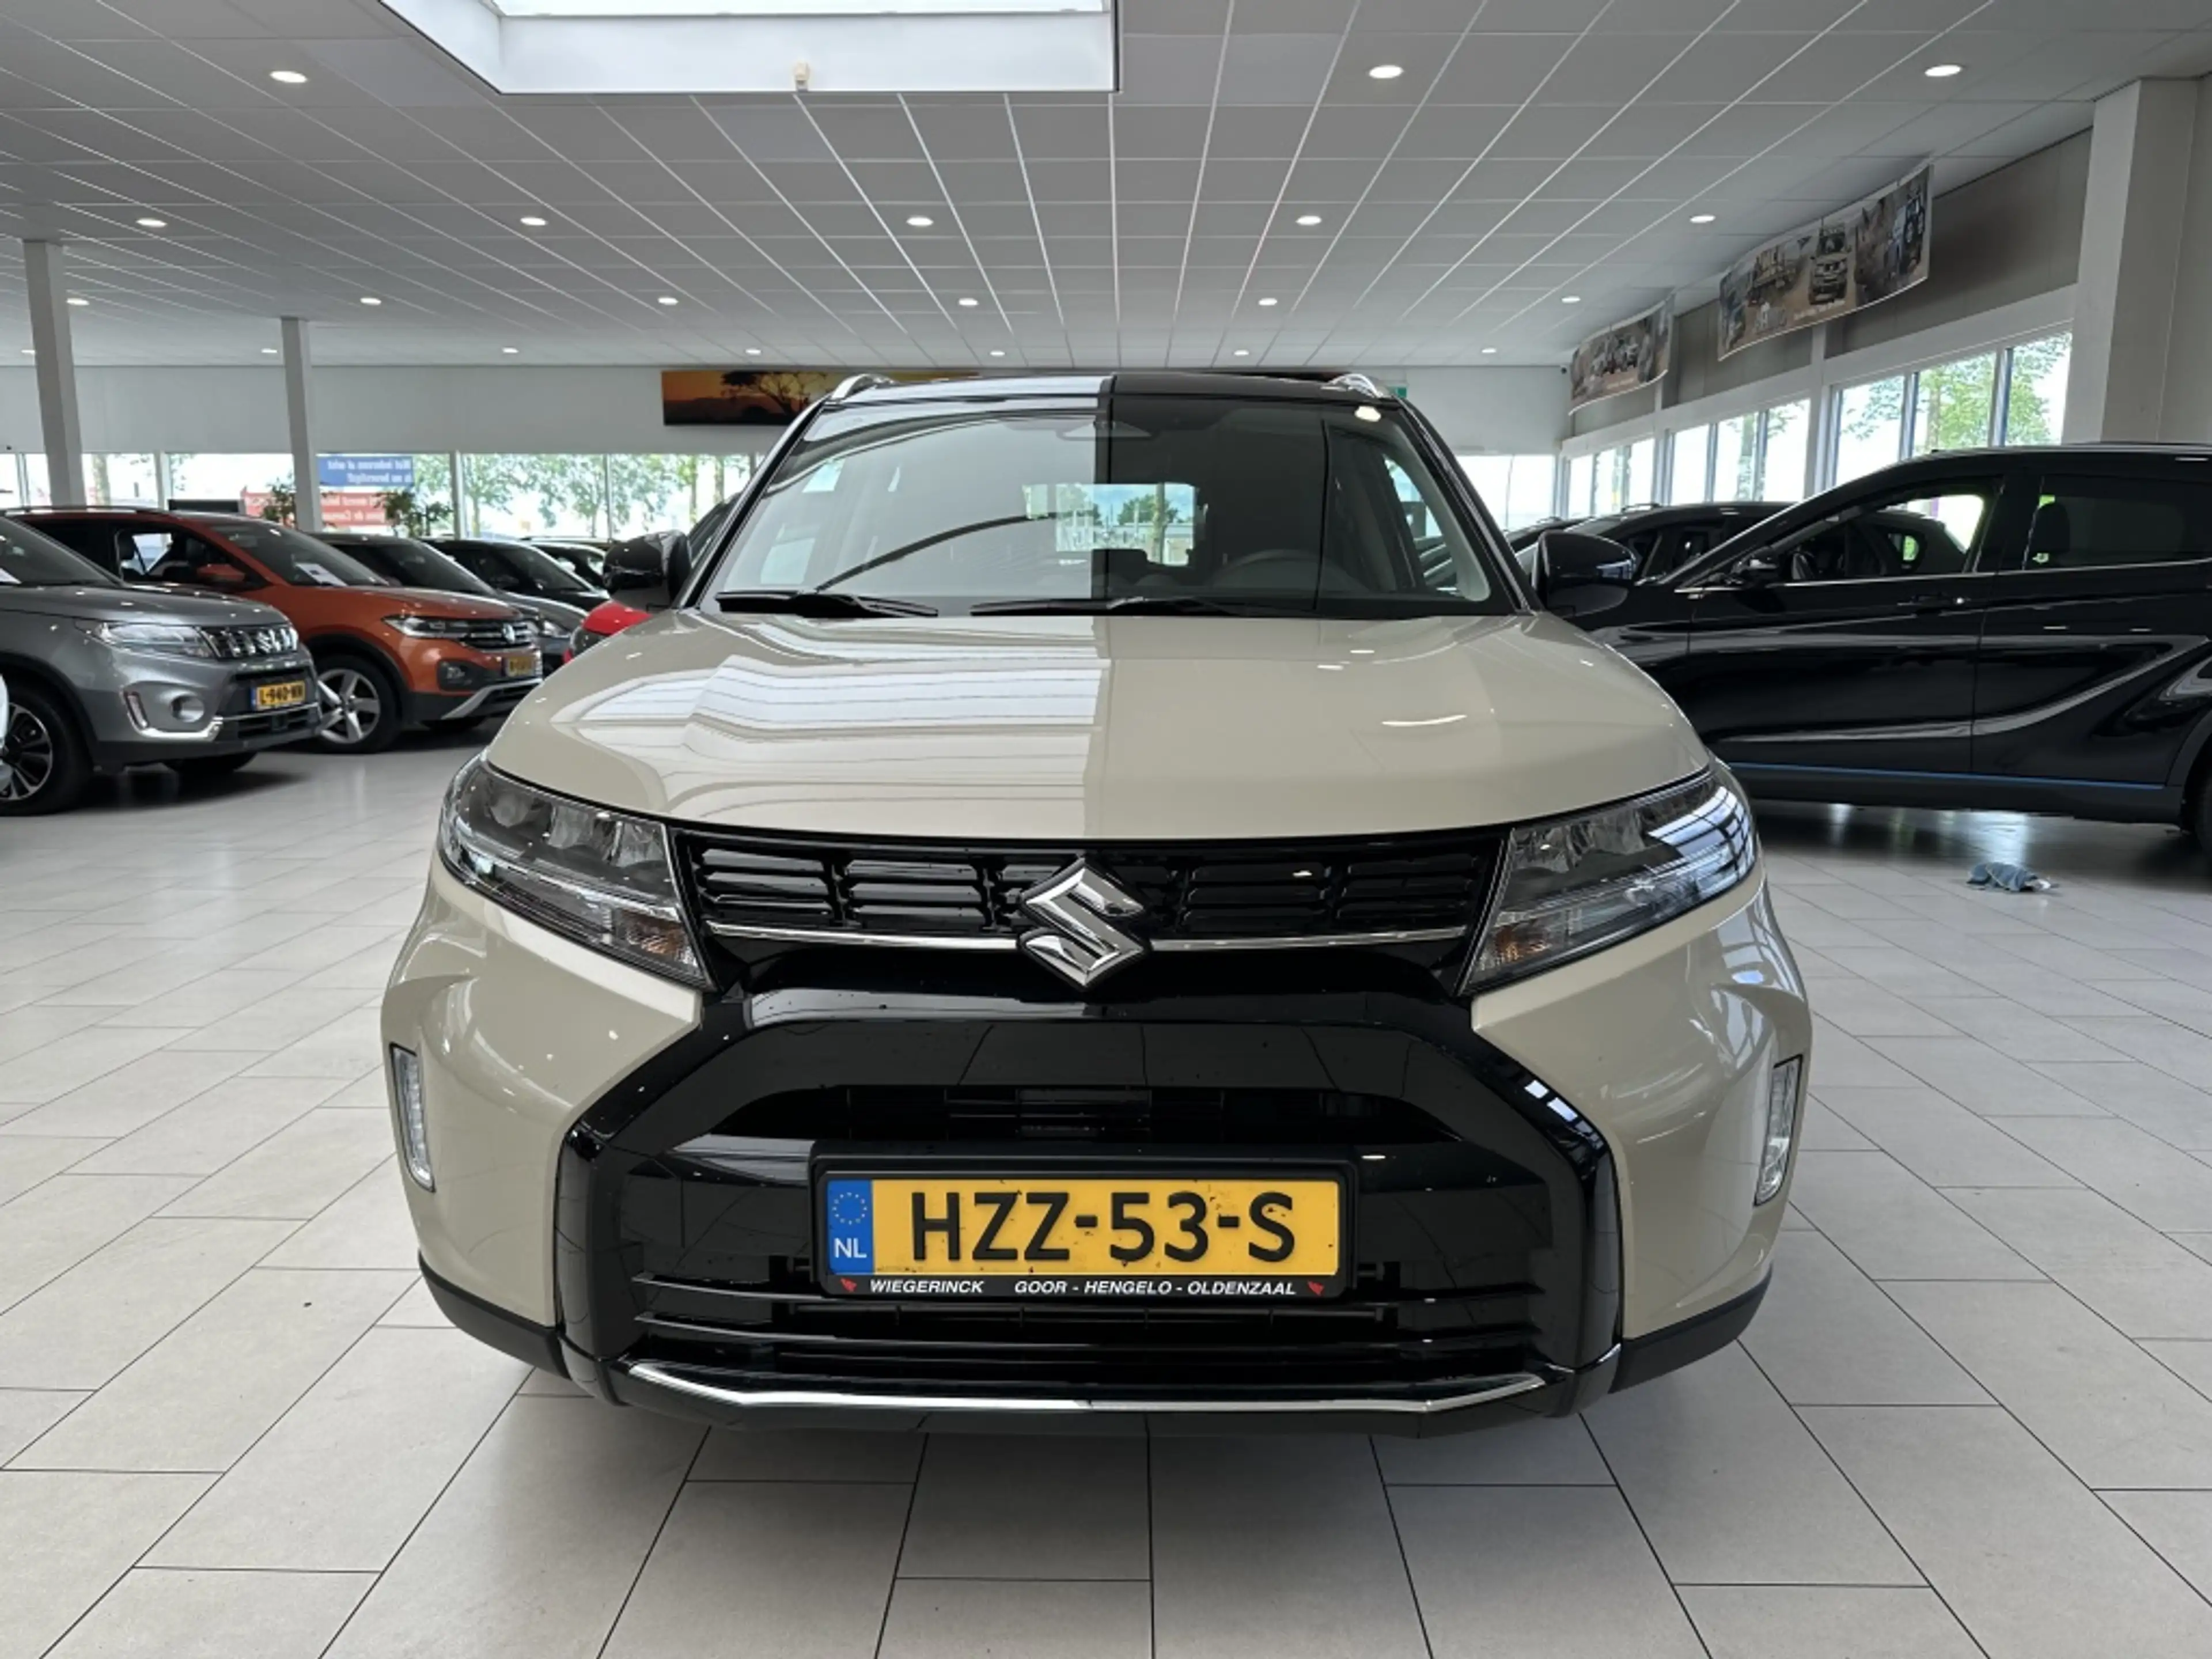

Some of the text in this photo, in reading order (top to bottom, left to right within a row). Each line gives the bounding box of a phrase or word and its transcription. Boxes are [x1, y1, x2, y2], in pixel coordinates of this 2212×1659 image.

[911, 1191, 1296, 1263] HZZ-53-S
[834, 1238, 867, 1259] NL
[870, 1279, 984, 1294] WIEGERINCK
[1014, 1281, 1068, 1294] GOOR
[1084, 1281, 1172, 1295] HENGELO
[1187, 1282, 1296, 1296] OLDENZAAL
